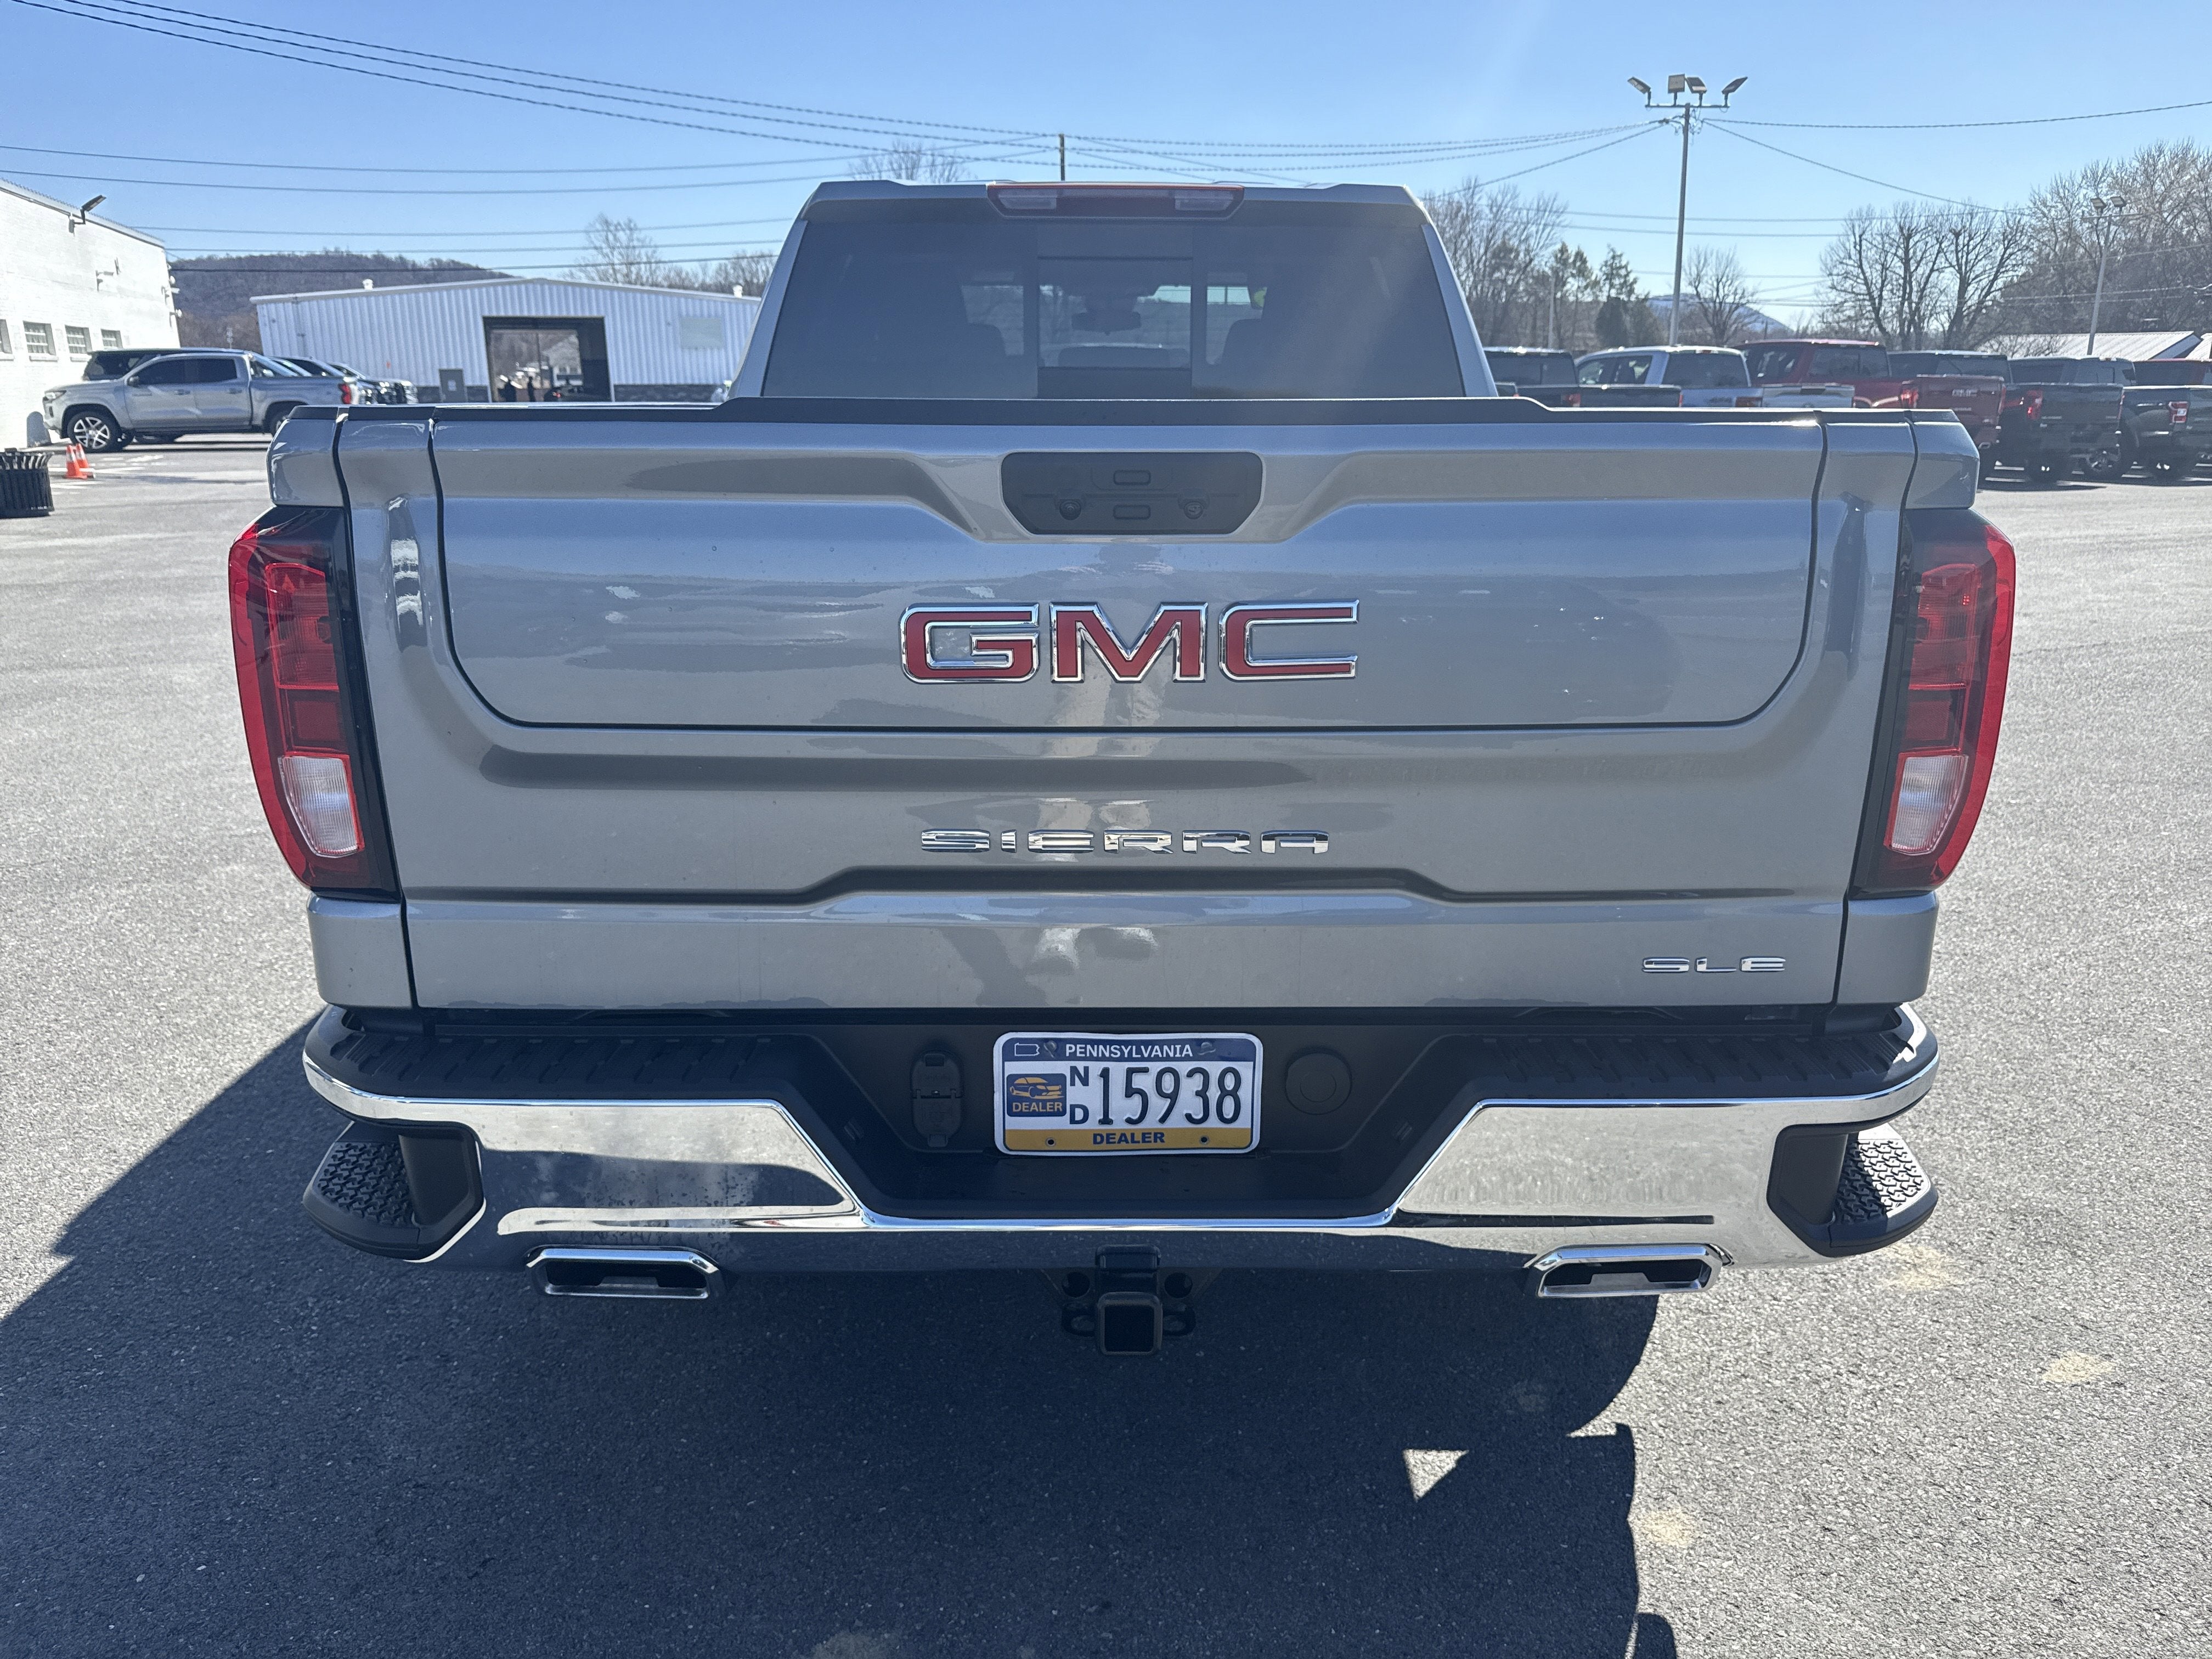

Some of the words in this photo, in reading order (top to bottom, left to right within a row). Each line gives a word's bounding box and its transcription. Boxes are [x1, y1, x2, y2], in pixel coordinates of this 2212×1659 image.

[900, 600, 1359, 683] GMC
[921, 829, 1329, 854] SIERRA
[1642, 956, 1786, 973] SLE
[1065, 1043, 1193, 1058] PENNSYLVANIA
[1069, 1065, 1089, 1086] N
[1098, 1066, 1242, 1125] 15938
[1012, 1102, 1063, 1112] DEALER
[1069, 1104, 1089, 1124] D
[1092, 1132, 1165, 1144] DEALER
